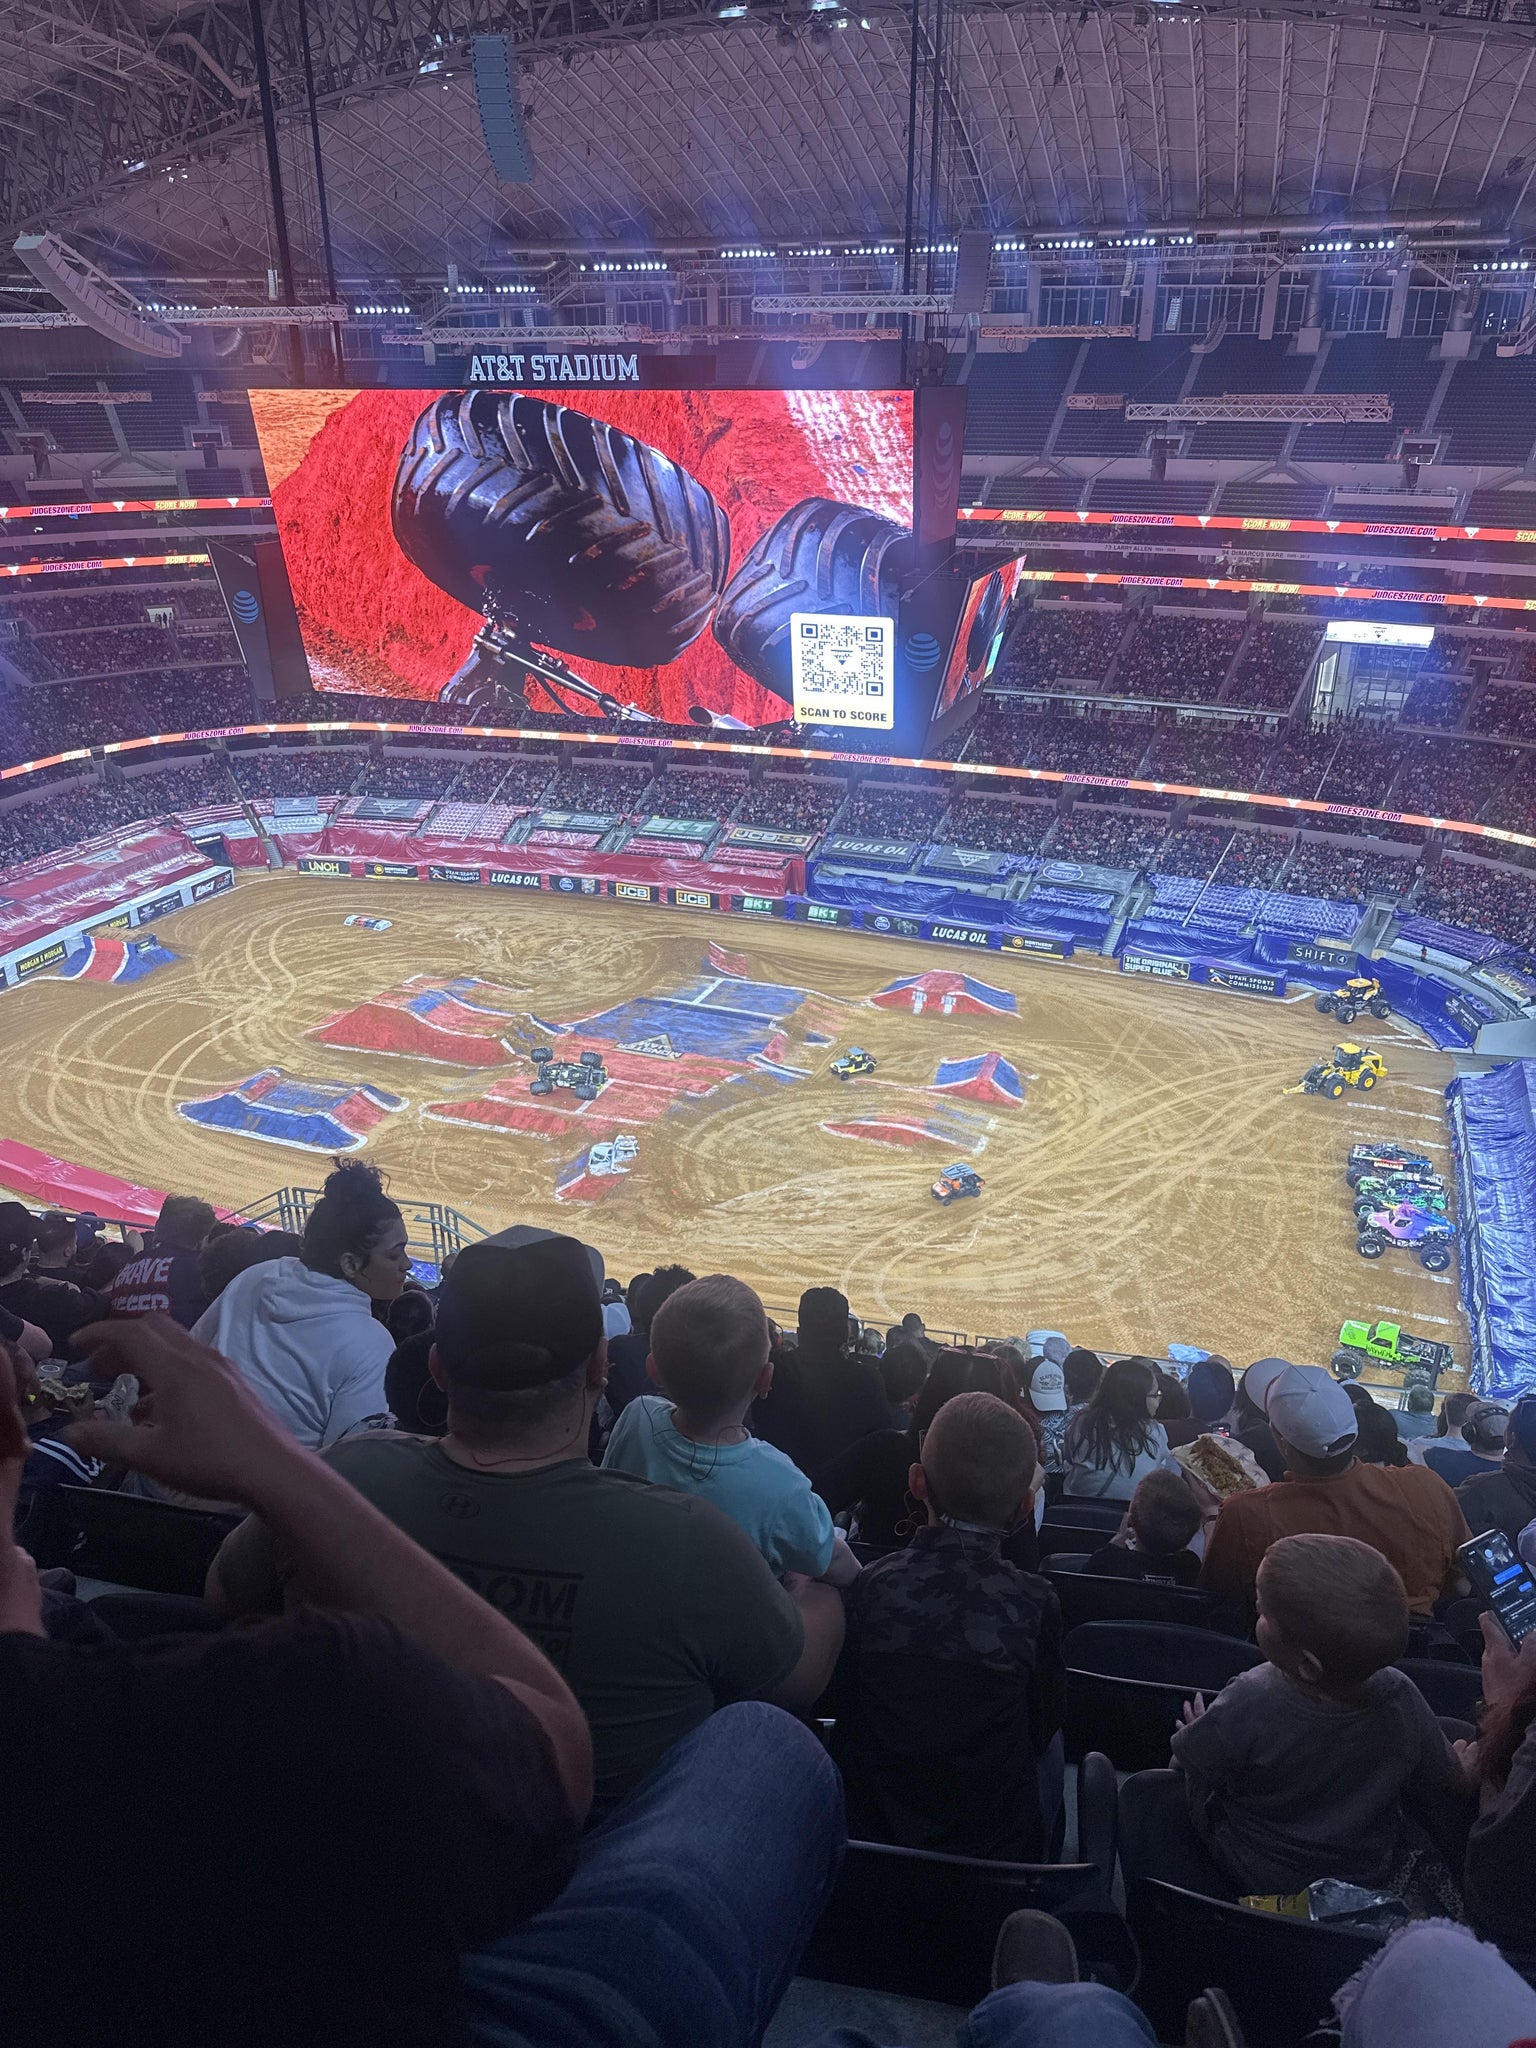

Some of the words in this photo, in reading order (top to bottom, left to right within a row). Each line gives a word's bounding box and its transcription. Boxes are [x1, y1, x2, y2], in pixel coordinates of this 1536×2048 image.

[470, 354, 524, 381] AT&T
[531, 354, 639, 381] STADIUM
[30, 504, 92, 516] JUDGESZONE.COM
[1002, 510, 1024, 520] SCORE
[1110, 514, 1174, 525] JUDGESZONE.COM
[1242, 519, 1267, 530] SCORE
[1269, 520, 1291, 530] NOW!
[1363, 524, 1437, 536] JUDGESZONE.COM
[1266, 551, 1284, 559] WARE
[41, 560, 102, 572] JUDGESZONE.COM
[1118, 575, 1183, 587] JUDGESZONE.COM
[1250, 582, 1276, 593] SCORE
[1277, 583, 1301, 595] NOW!
[1372, 590, 1446, 603] JUDGESZONE.COM
[800, 706, 830, 718] SCAN
[833, 709, 847, 719] TO
[850, 710, 888, 722] SCORE
[183, 726, 245, 740] JUDGESZONE.COM
[408, 724, 463, 735] JUDGESZONE.COM
[617, 736, 673, 748] JUDGESZONE.COM
[830, 752, 891, 764] JUDGESZONE.COM
[1062, 774, 1129, 788] JUDGESZONE.COM
[1324, 804, 1402, 823] JUDGESZONE.COM
[832, 840, 883, 853] LUCAS
[884, 845, 910, 857] OIL
[308, 861, 340, 872] UNOH
[491, 872, 522, 885] LUCAS
[523, 875, 541, 887] OIL
[618, 885, 648, 899] JCB
[678, 893, 708, 905] JCB
[743, 897, 772, 911] BKT
[808, 905, 838, 920] BKT
[932, 926, 967, 942] LUCAS
[968, 930, 988, 944] OIL
[20, 956, 40, 972] MORGAN
[44, 946, 63, 961] MORGAN
[1295, 947, 1334, 963] SHIFT
[1125, 955, 1141, 965] THE
[1141, 958, 1176, 970] ORIGINAL
[1125, 962, 1151, 973] SUPER
[1152, 966, 1173, 976] GLUE
[1228, 979, 1275, 992] COMMISSION
[1229, 974, 1248, 984] UTAH
[1249, 977, 1275, 987] SPORTS
